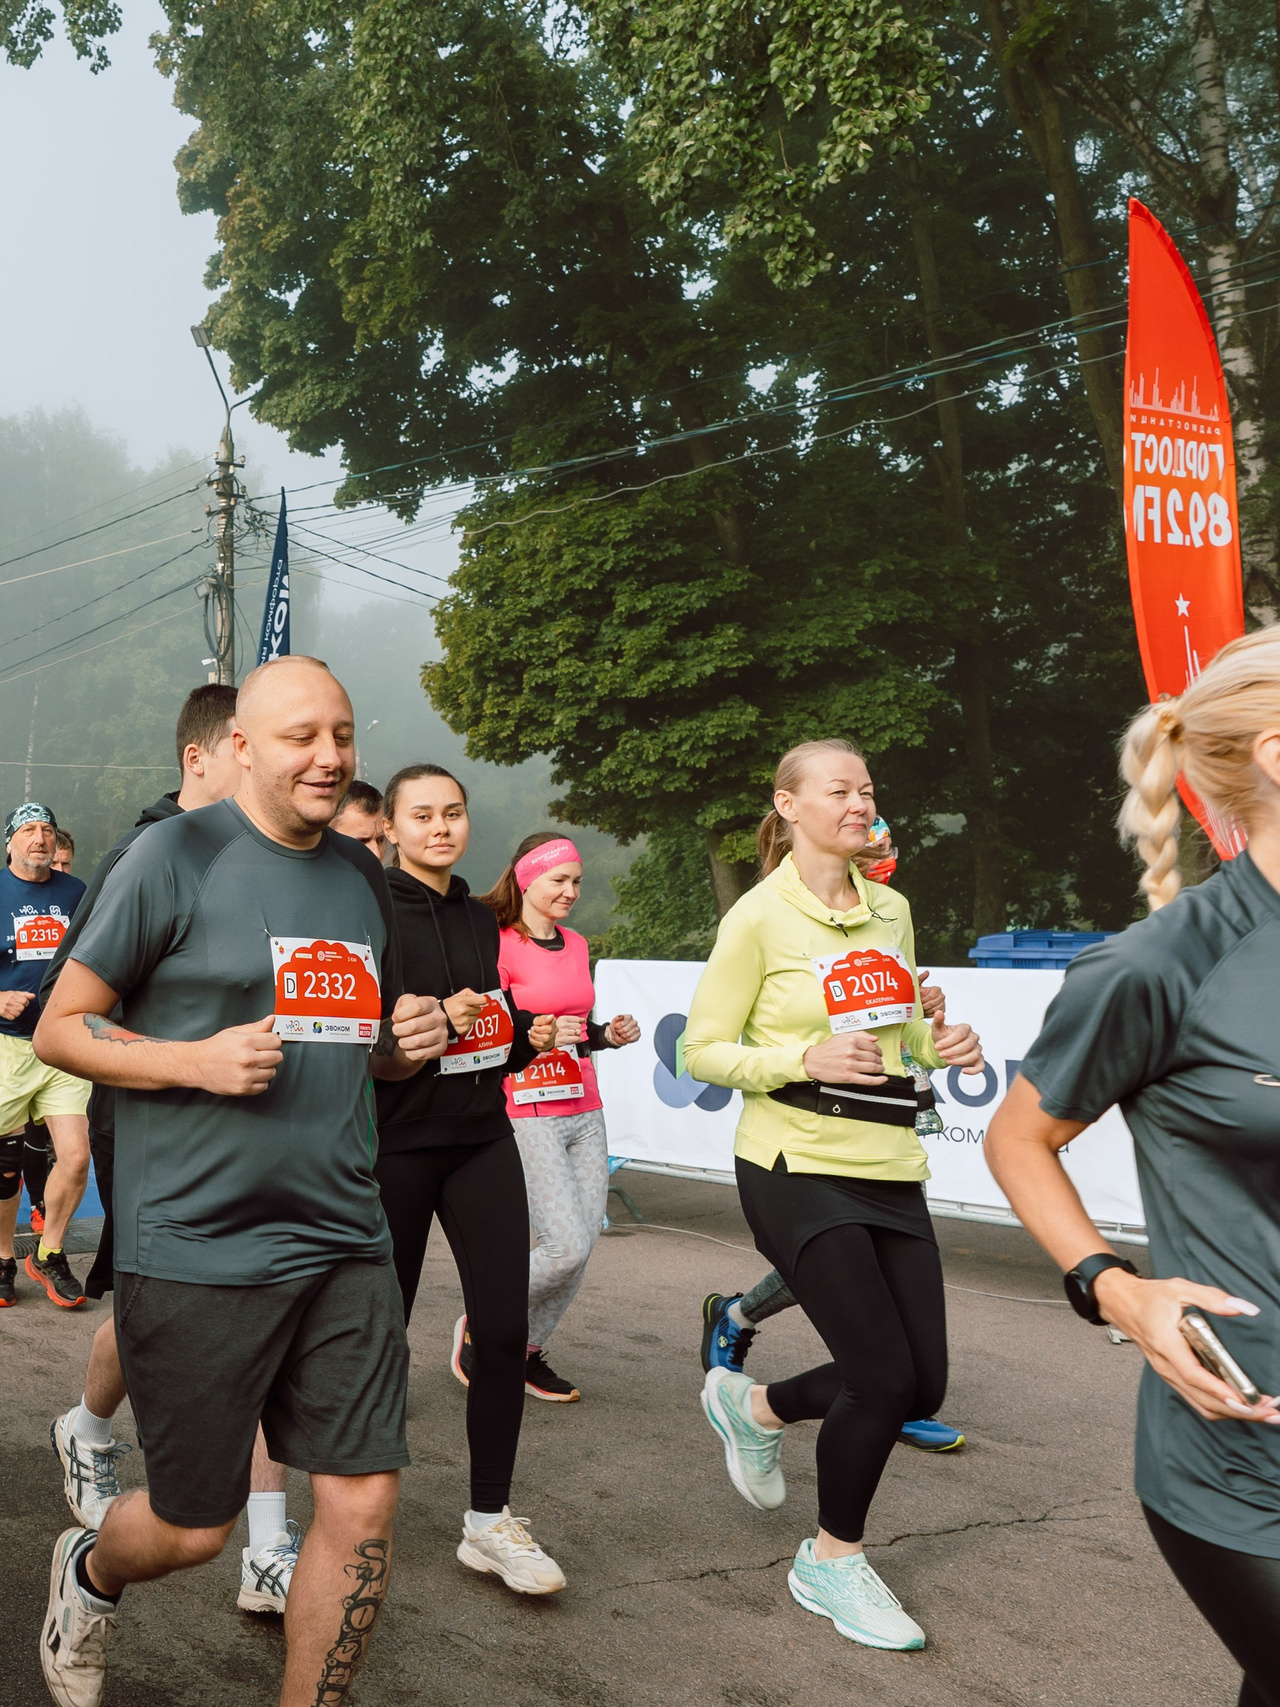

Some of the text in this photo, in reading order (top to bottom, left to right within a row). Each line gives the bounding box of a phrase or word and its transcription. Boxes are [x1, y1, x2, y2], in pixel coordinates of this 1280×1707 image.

[30, 928, 59, 942] 2315
[286, 970, 357, 1000] D 2332
[833, 971, 898, 998] D 2074
[865, 996, 895, 1006] ЕКАТЕРИНА
[324, 1024, 350, 1032] ЭВОКОМ
[528, 1061, 566, 1080] 2114
